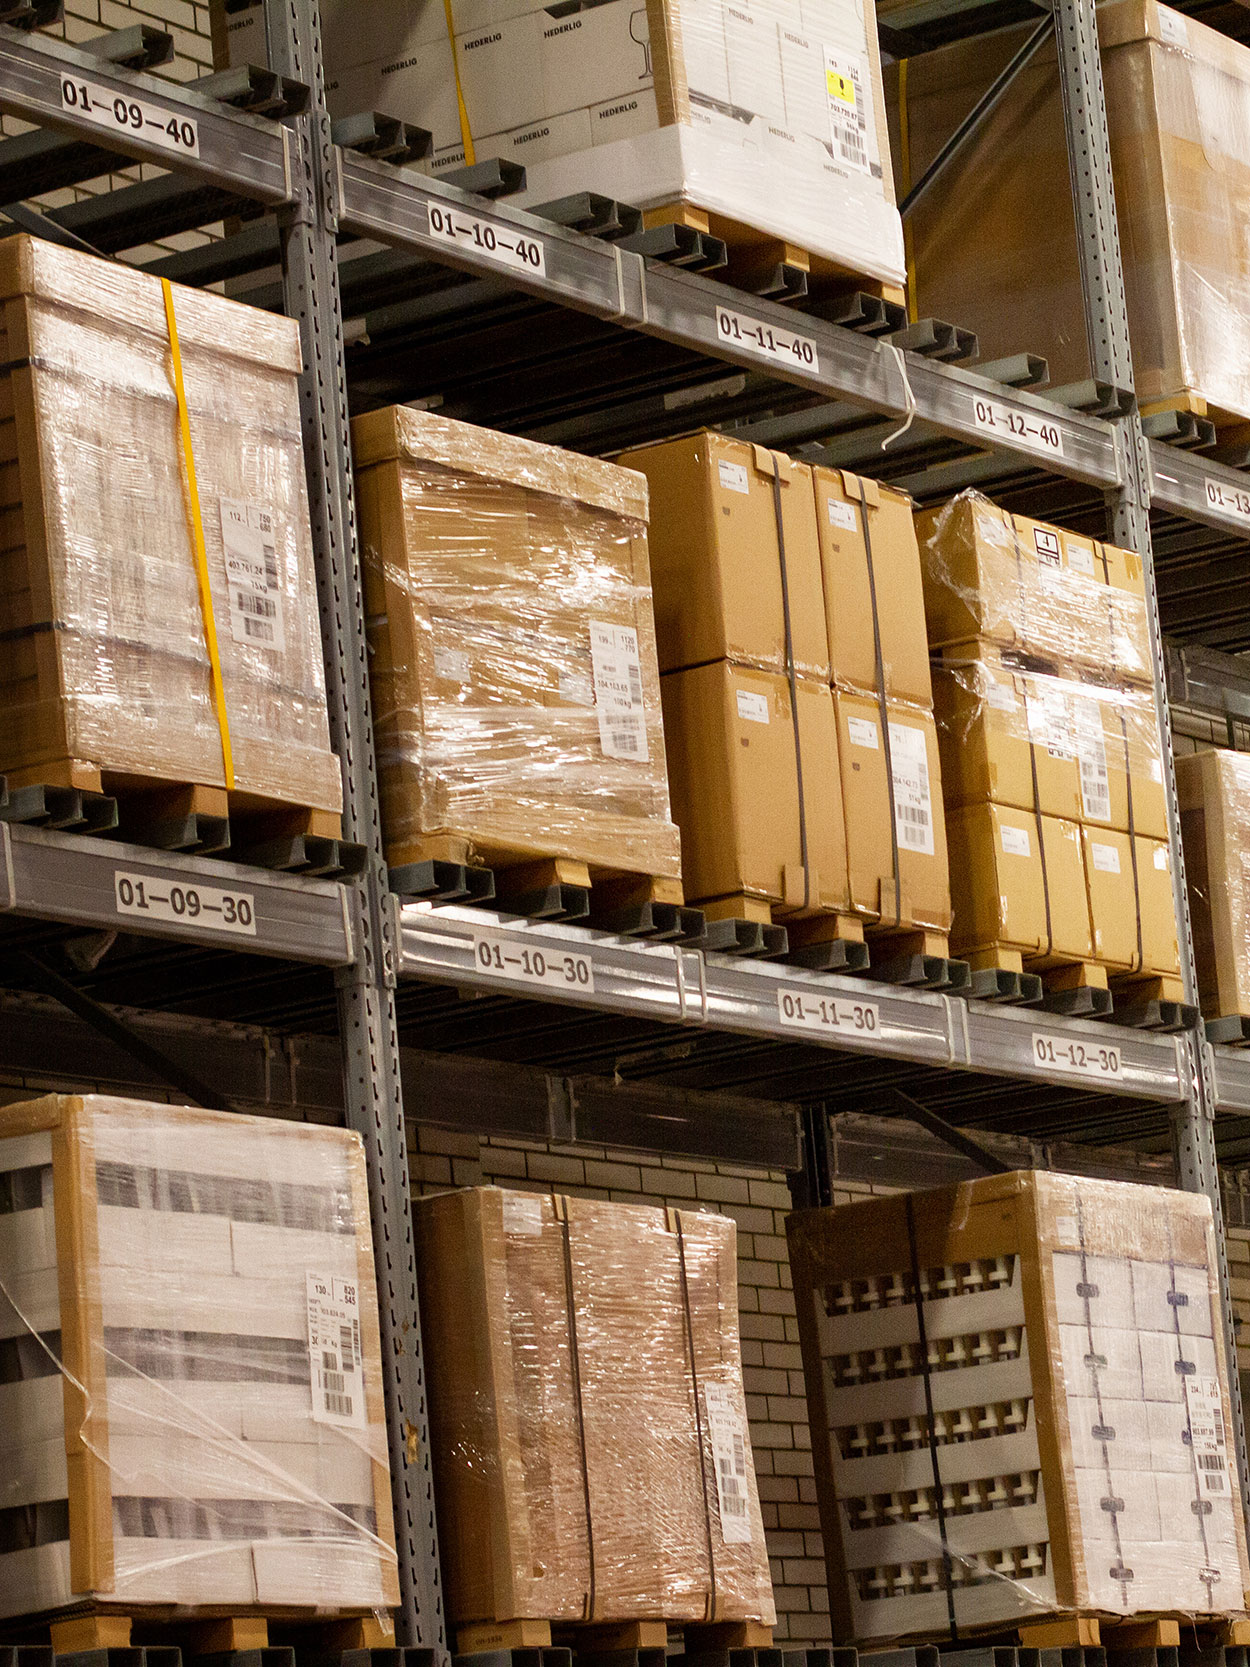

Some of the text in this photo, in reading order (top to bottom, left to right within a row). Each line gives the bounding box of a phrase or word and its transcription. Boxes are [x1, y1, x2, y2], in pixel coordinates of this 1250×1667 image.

[228, 18, 254, 32] DERLIG
[544, 20, 582, 39] HEDERLIG
[464, 33, 502, 51] HEDERLIG
[381, 58, 418, 75] HEDERLIG
[62, 80, 195, 148] 01-09-40
[599, 101, 638, 119] HEDERLIG
[513, 128, 549, 145] HEDERLIG
[430, 208, 540, 267] 01-10-40
[720, 313, 813, 364] 01-11-40
[977, 402, 1059, 448] 01-12-40
[1043, 536, 1050, 547] 4
[119, 879, 251, 927] 01-09-30
[479, 941, 588, 984] 01-10-30
[783, 995, 875, 1031] 01-11-30
[1037, 1039, 1118, 1073] 01-12-30
[315, 1284, 327, 1295] 130
